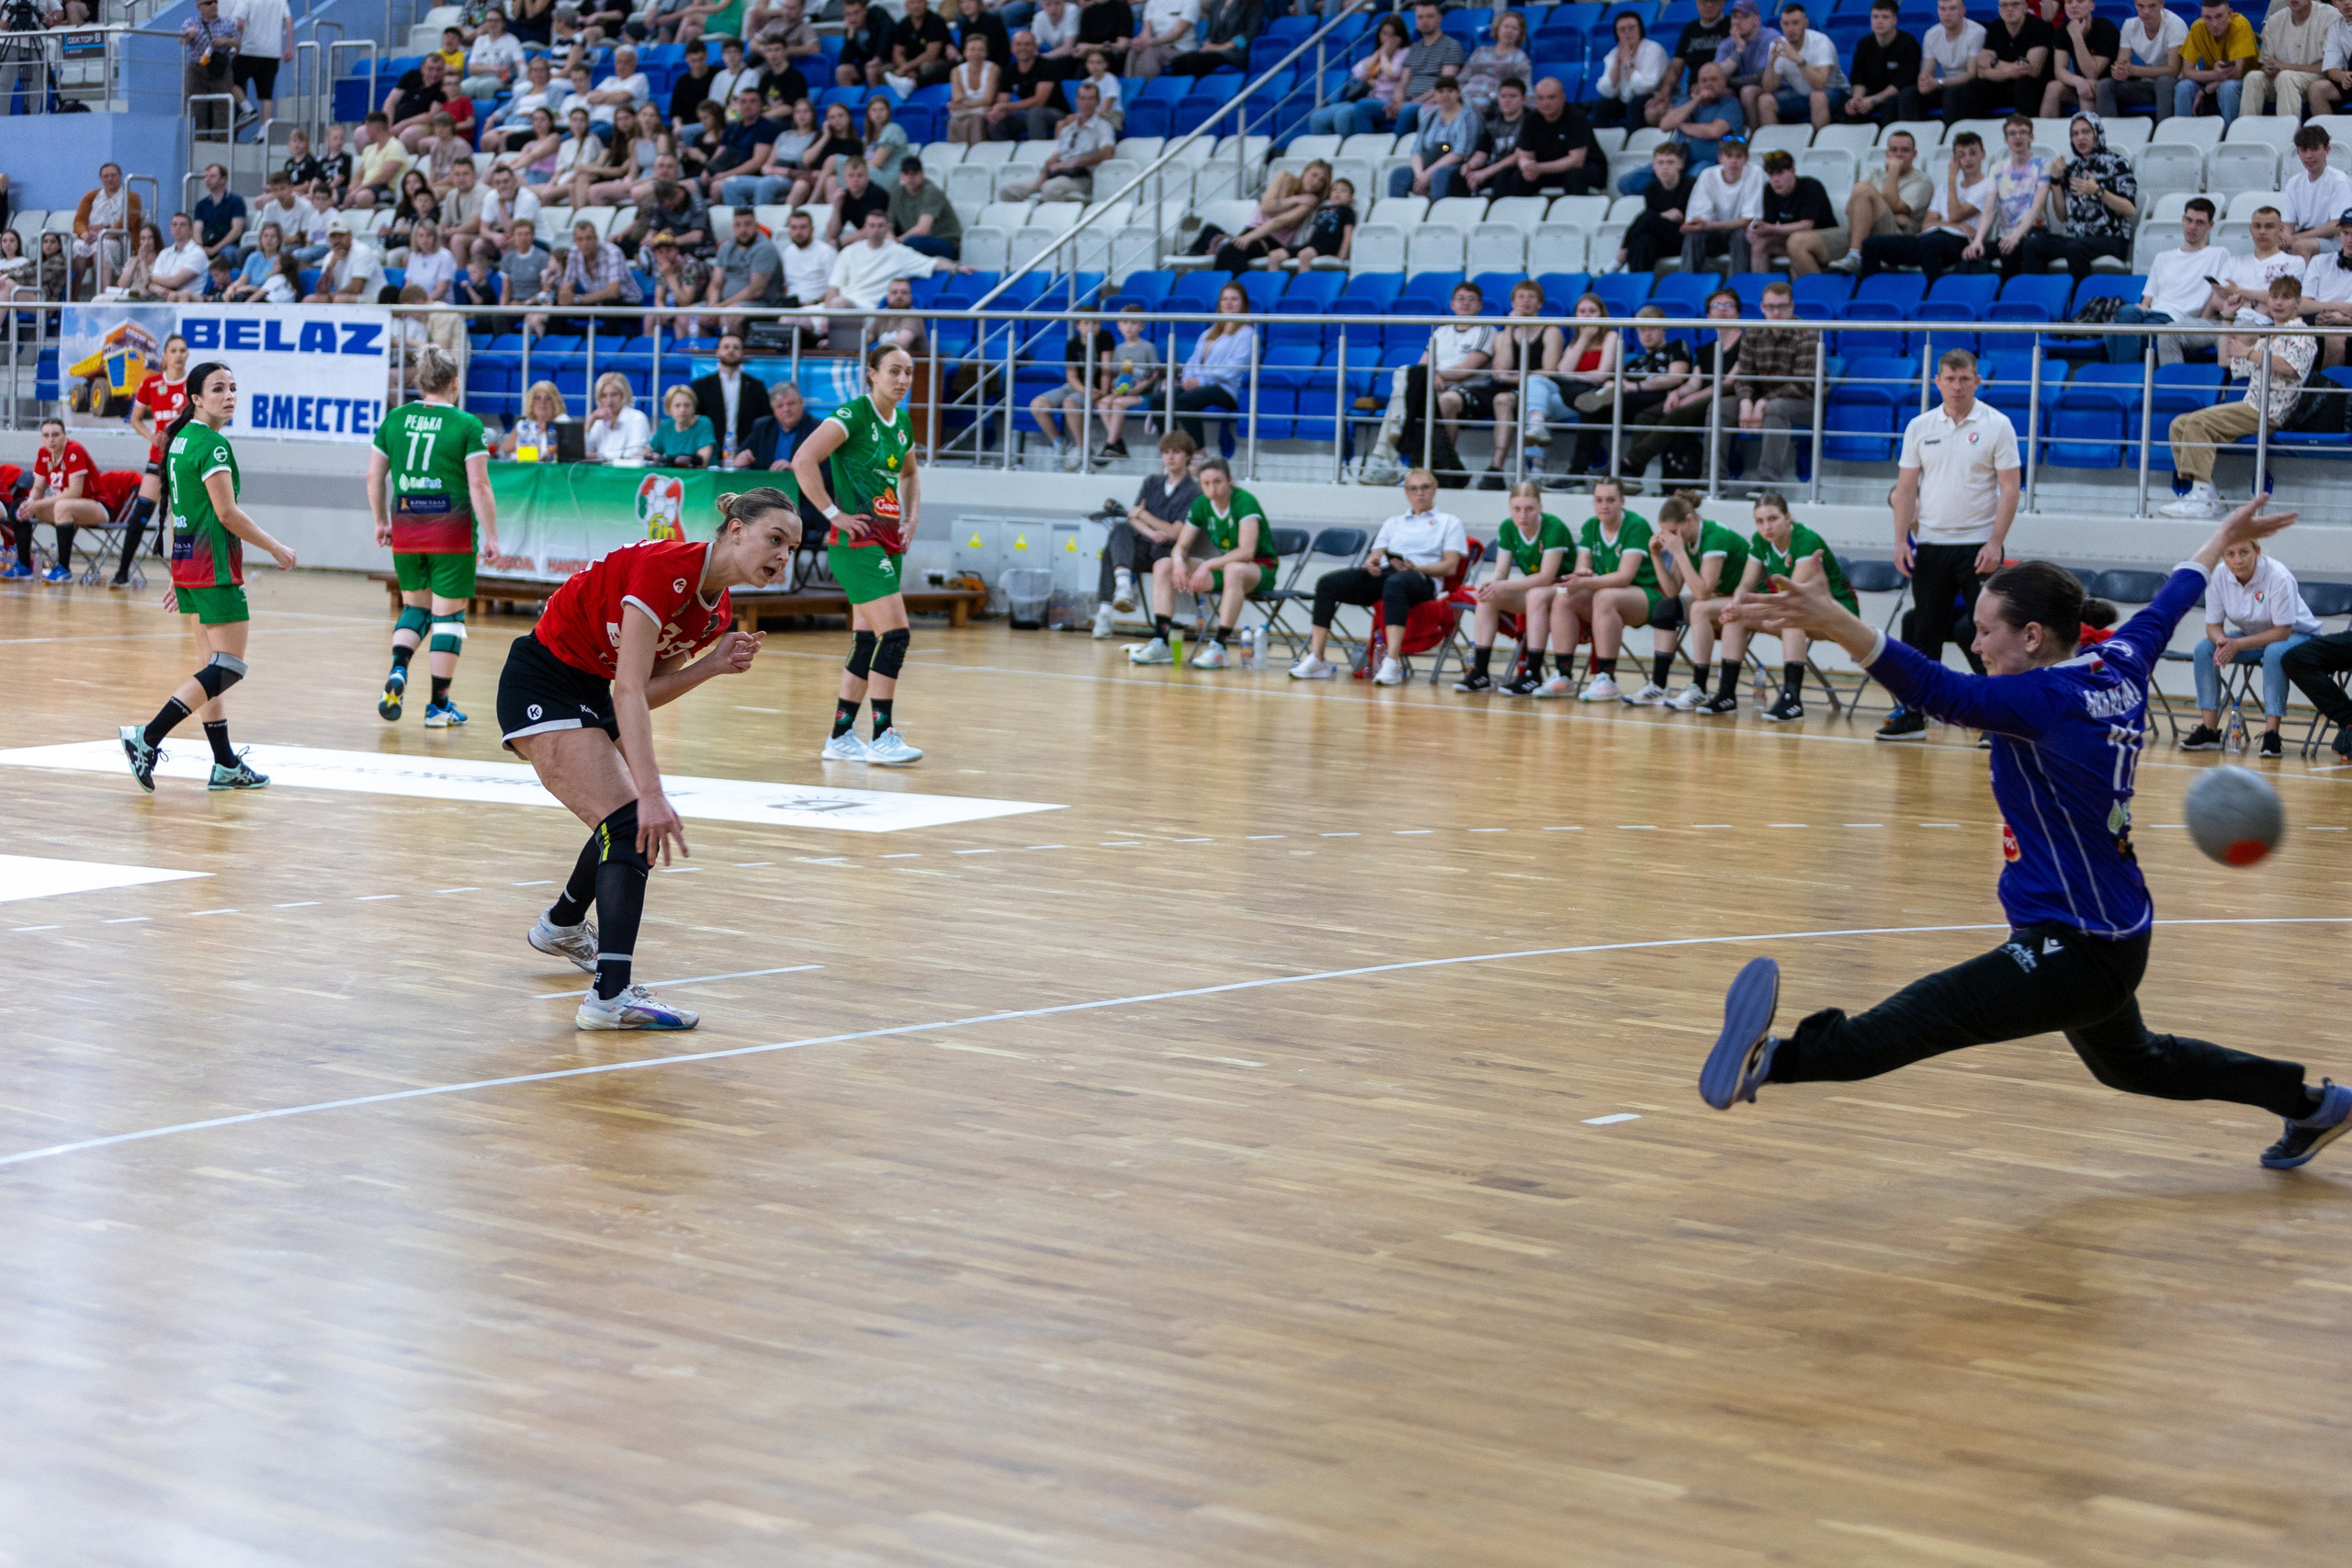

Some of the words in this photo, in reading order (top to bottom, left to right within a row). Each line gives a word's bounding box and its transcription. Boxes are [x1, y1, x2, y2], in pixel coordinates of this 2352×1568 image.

[182, 318, 383, 355] BELAZ
[172, 392, 185, 410] 9
[252, 393, 382, 435] ВМЕСТЕ!
[404, 413, 443, 432] РЕДЬКА
[872, 422, 879, 442] 3
[406, 431, 436, 472] 77
[169, 457, 179, 504] 5
